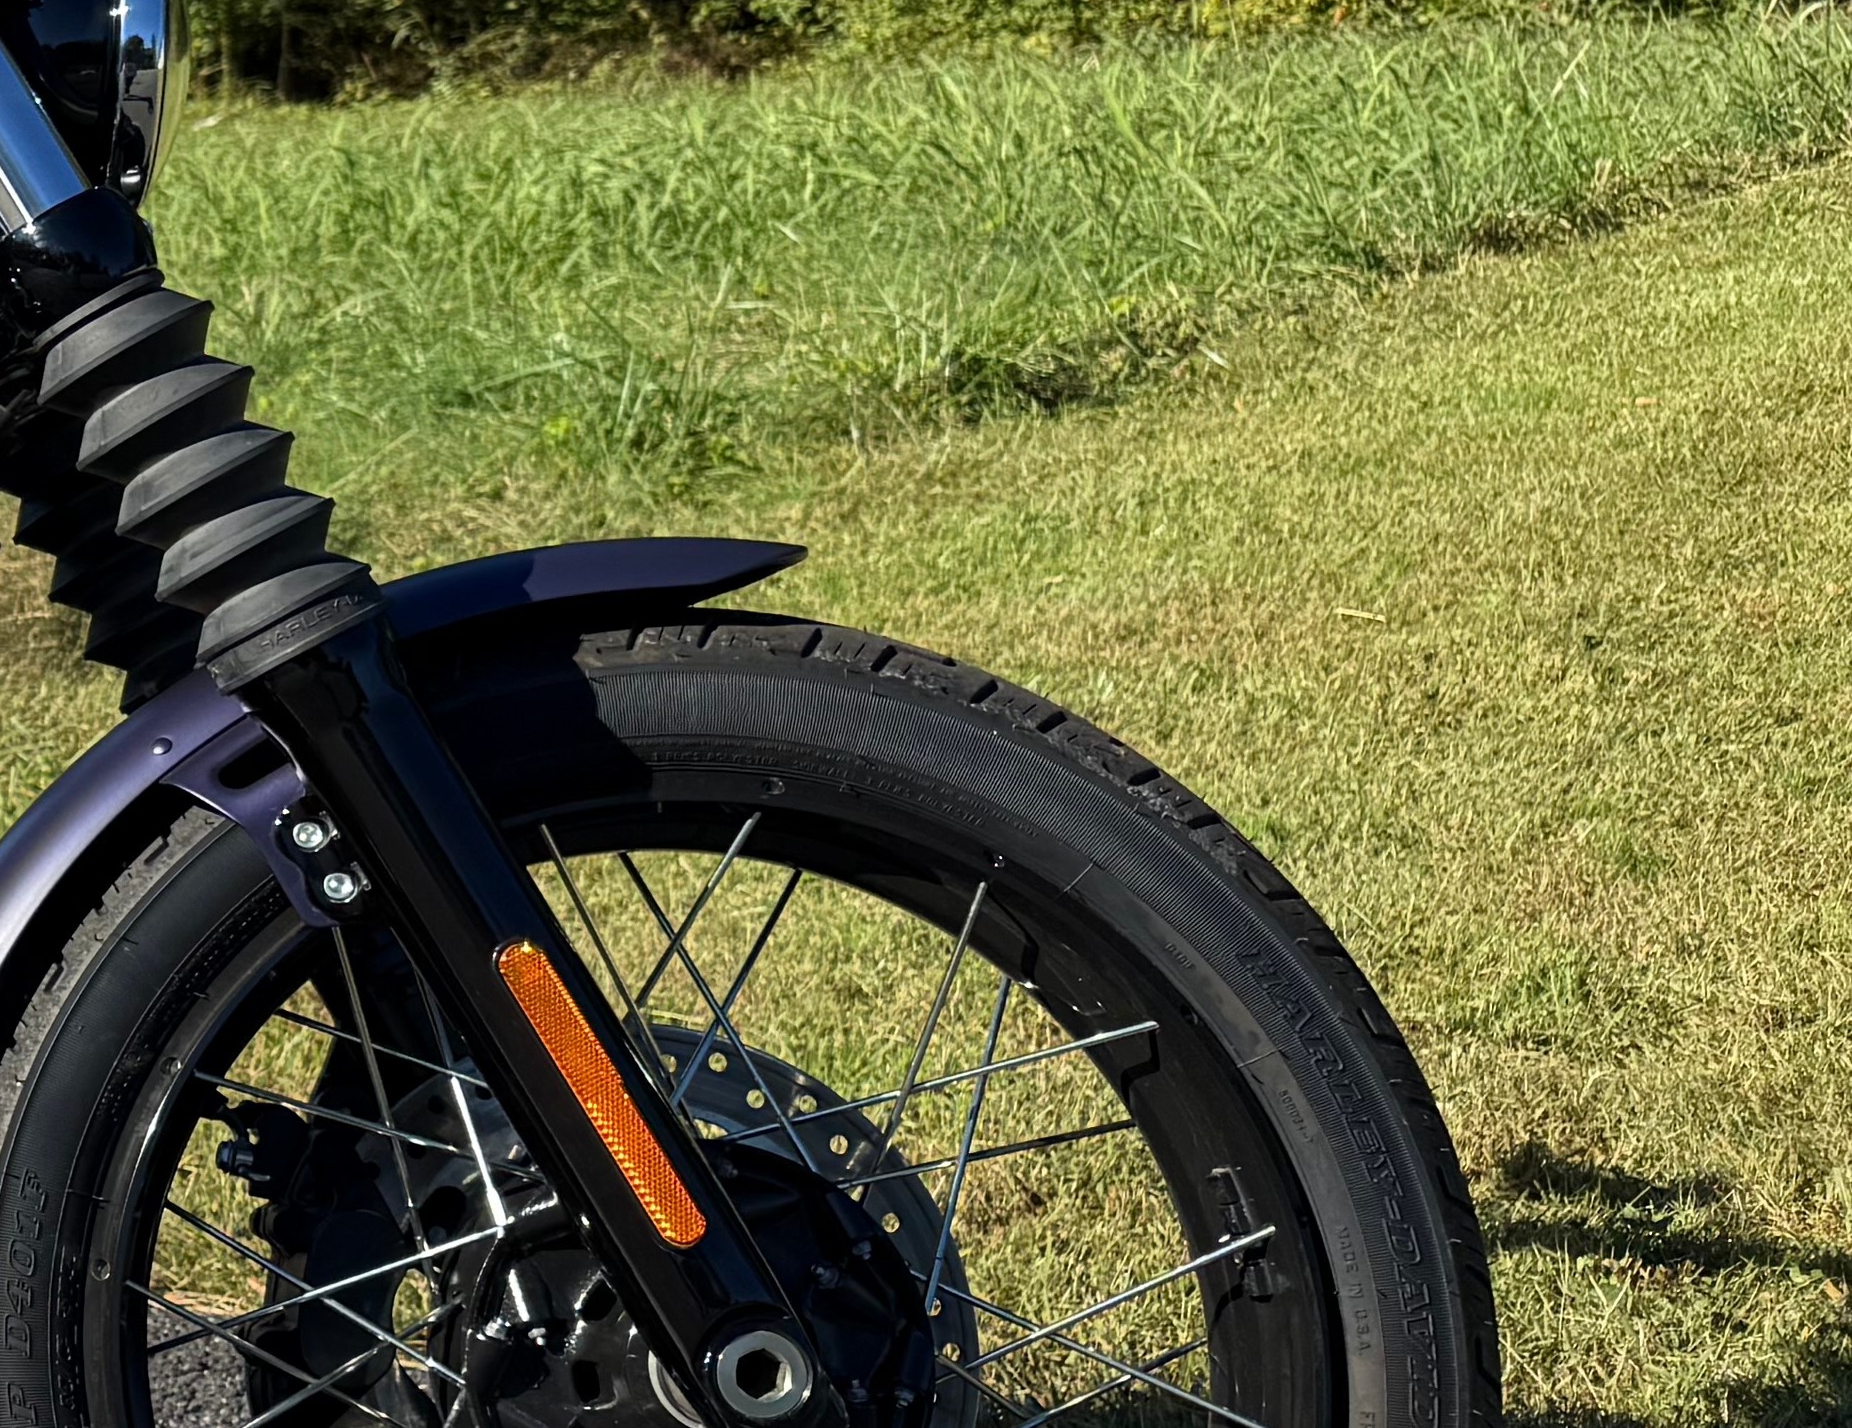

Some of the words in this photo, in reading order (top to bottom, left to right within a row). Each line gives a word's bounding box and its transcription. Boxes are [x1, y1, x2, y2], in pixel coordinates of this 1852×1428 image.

[2, 1169, 50, 1359] D401F
[1335, 1226, 1358, 1273] MADE
[1347, 1282, 1363, 1298] IN
